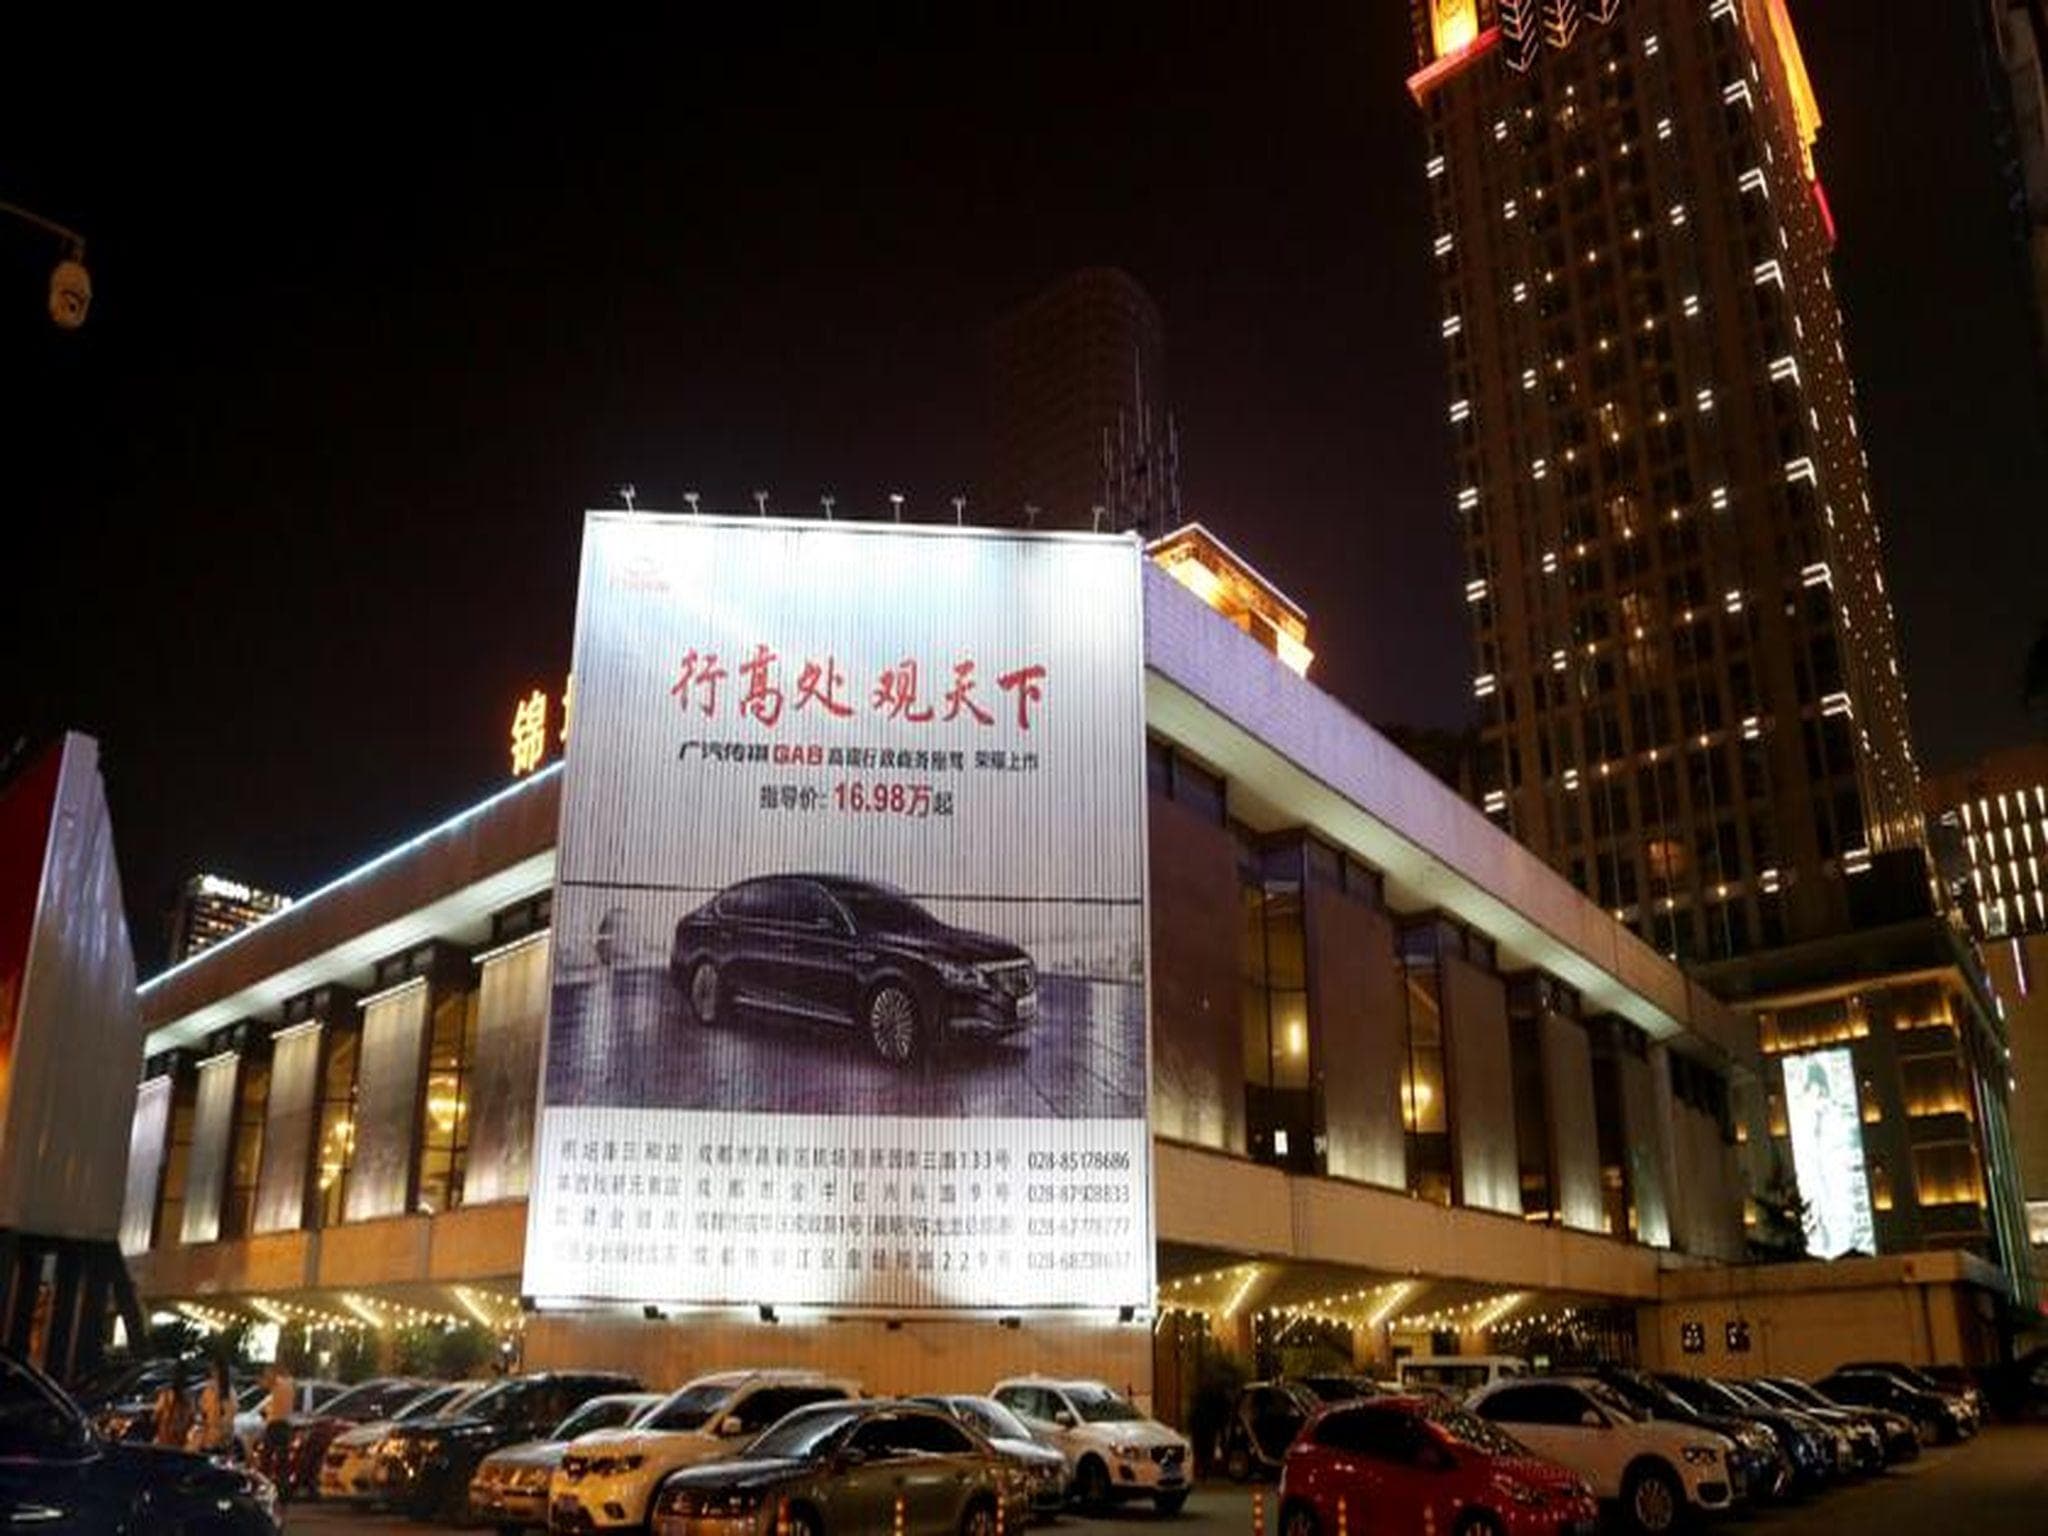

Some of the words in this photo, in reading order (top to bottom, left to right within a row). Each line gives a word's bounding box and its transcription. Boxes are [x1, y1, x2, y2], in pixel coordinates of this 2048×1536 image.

[671, 643, 854, 727] 行高处
[873, 657, 1047, 730] 观天下
[833, 781, 954, 819] 16.98万起
